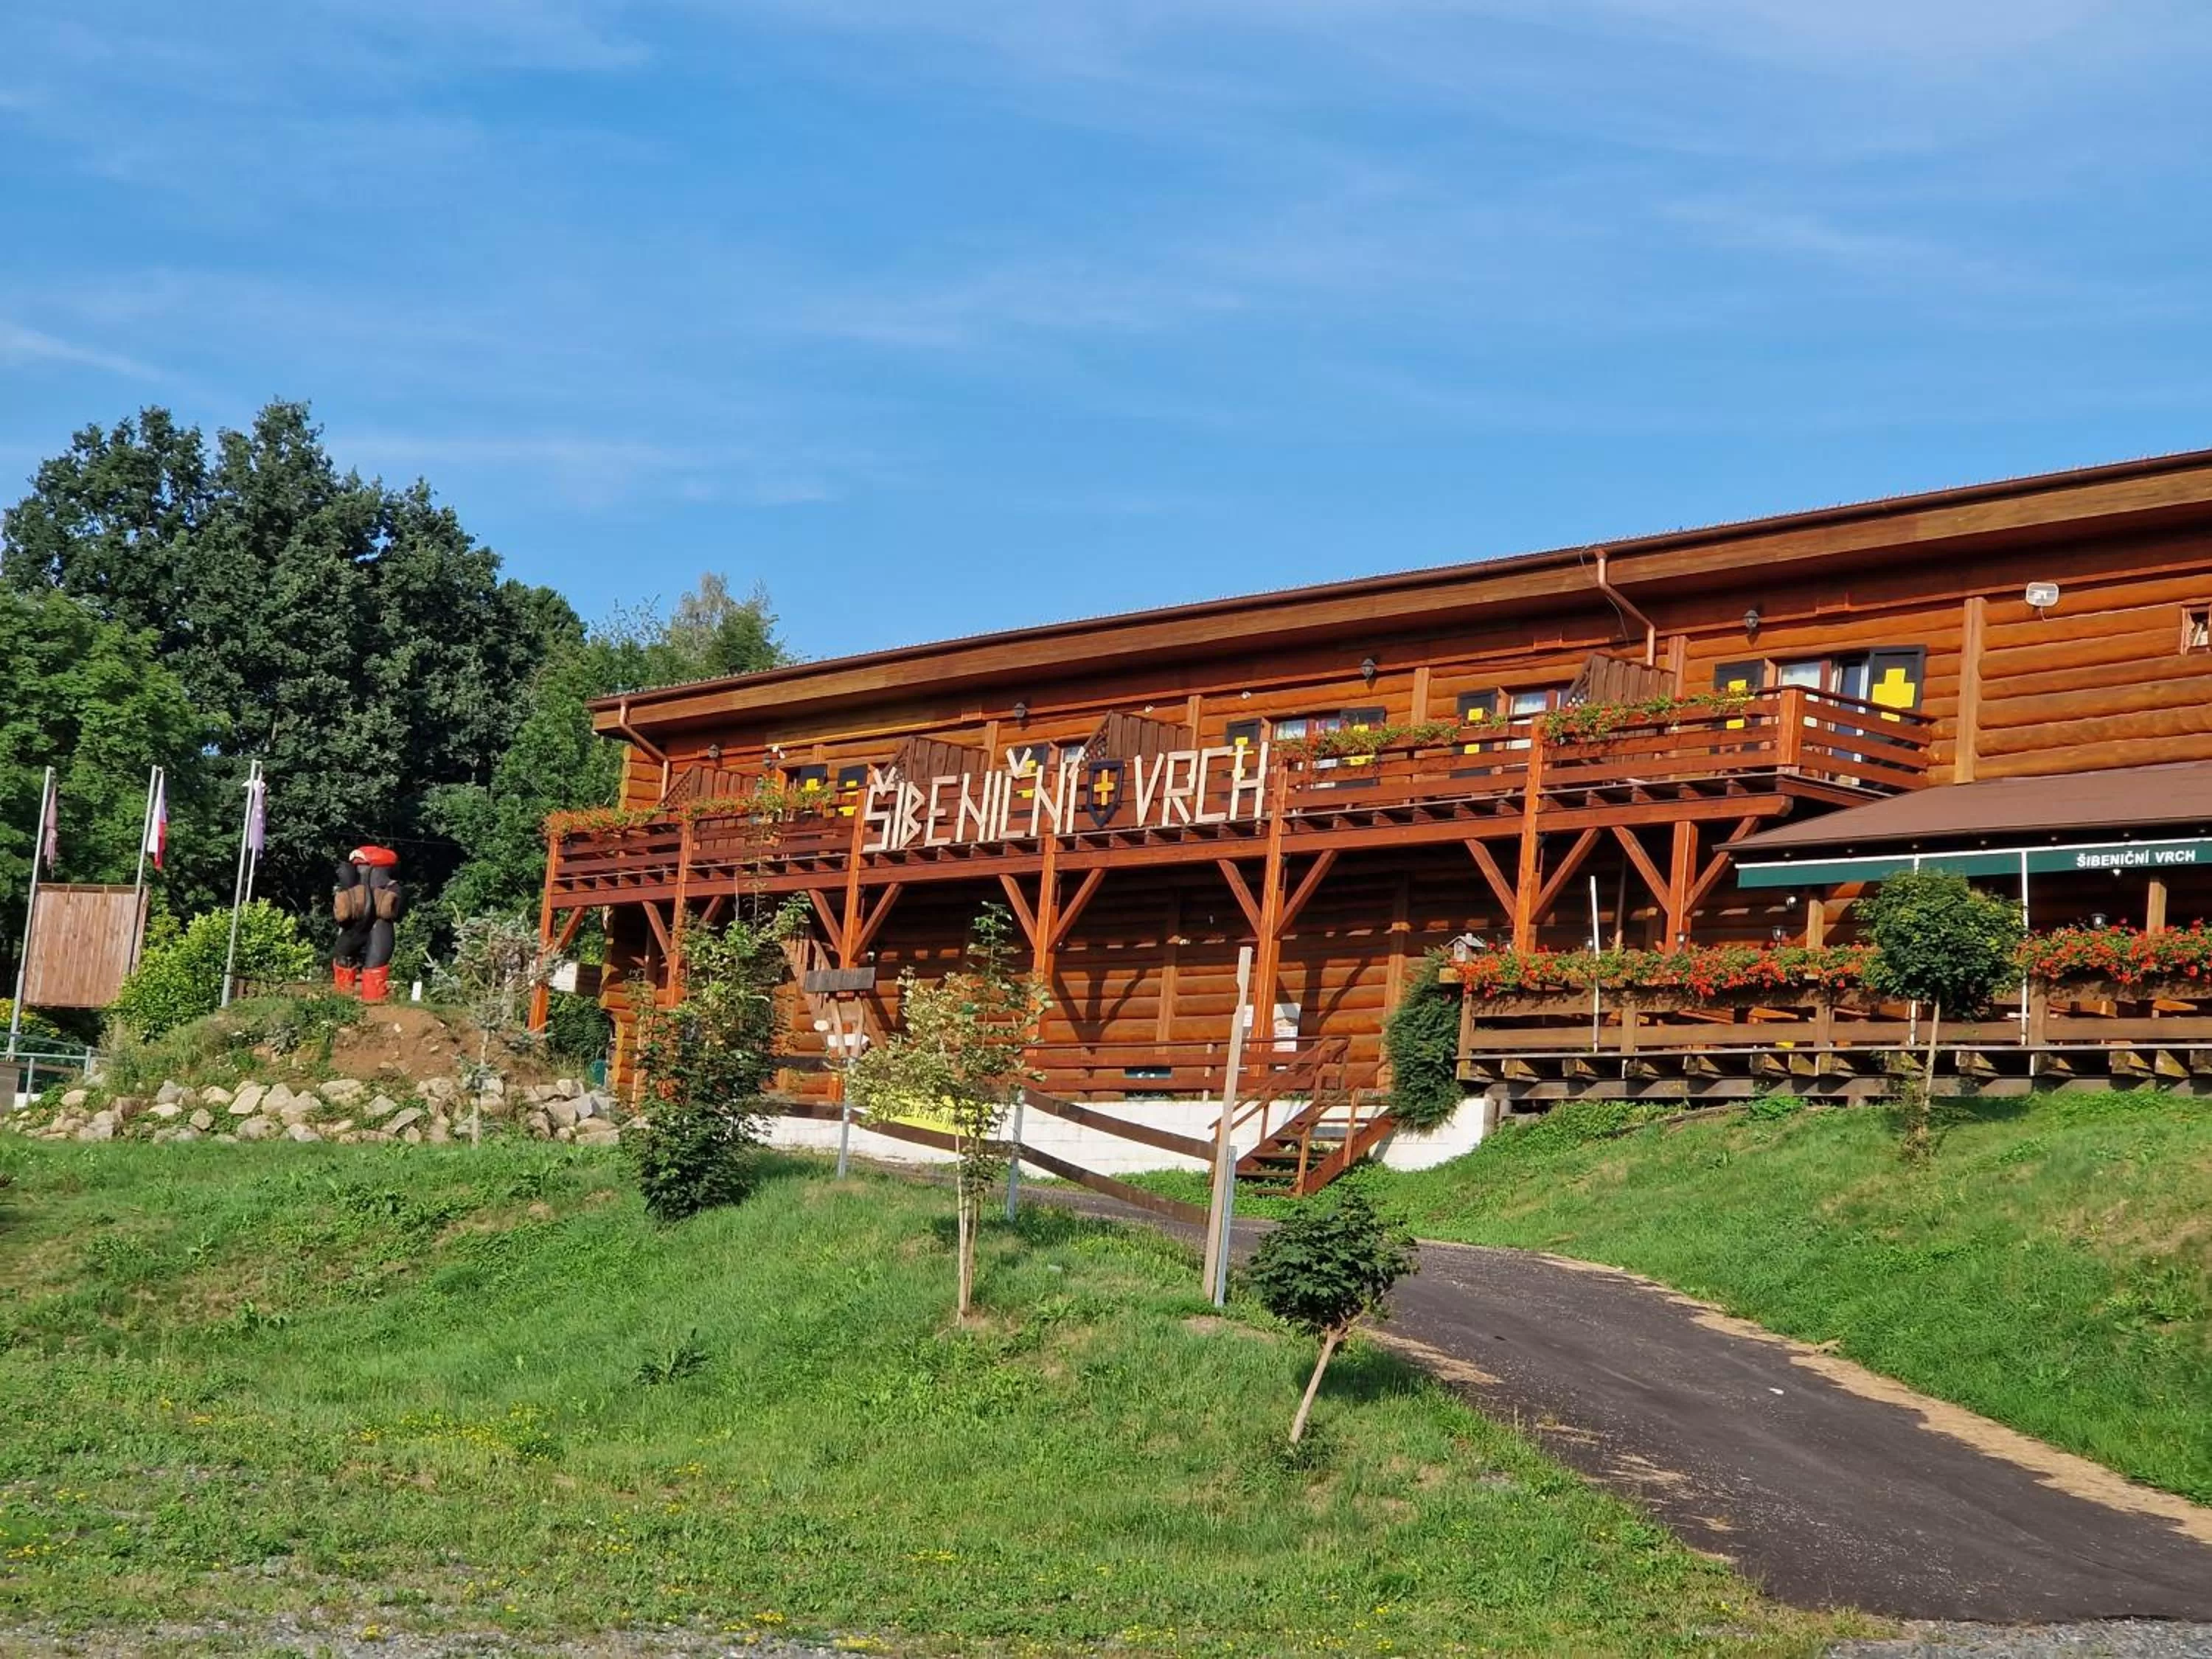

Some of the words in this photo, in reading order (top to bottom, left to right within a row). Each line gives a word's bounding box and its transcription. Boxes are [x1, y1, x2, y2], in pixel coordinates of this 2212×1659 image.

[862, 745, 1084, 852] ŠIBENIČNÍ
[1134, 741, 1268, 827] VRCH
[2076, 849, 2149, 868] ŠIBENIČNÍ
[2155, 849, 2196, 863] VRCH
